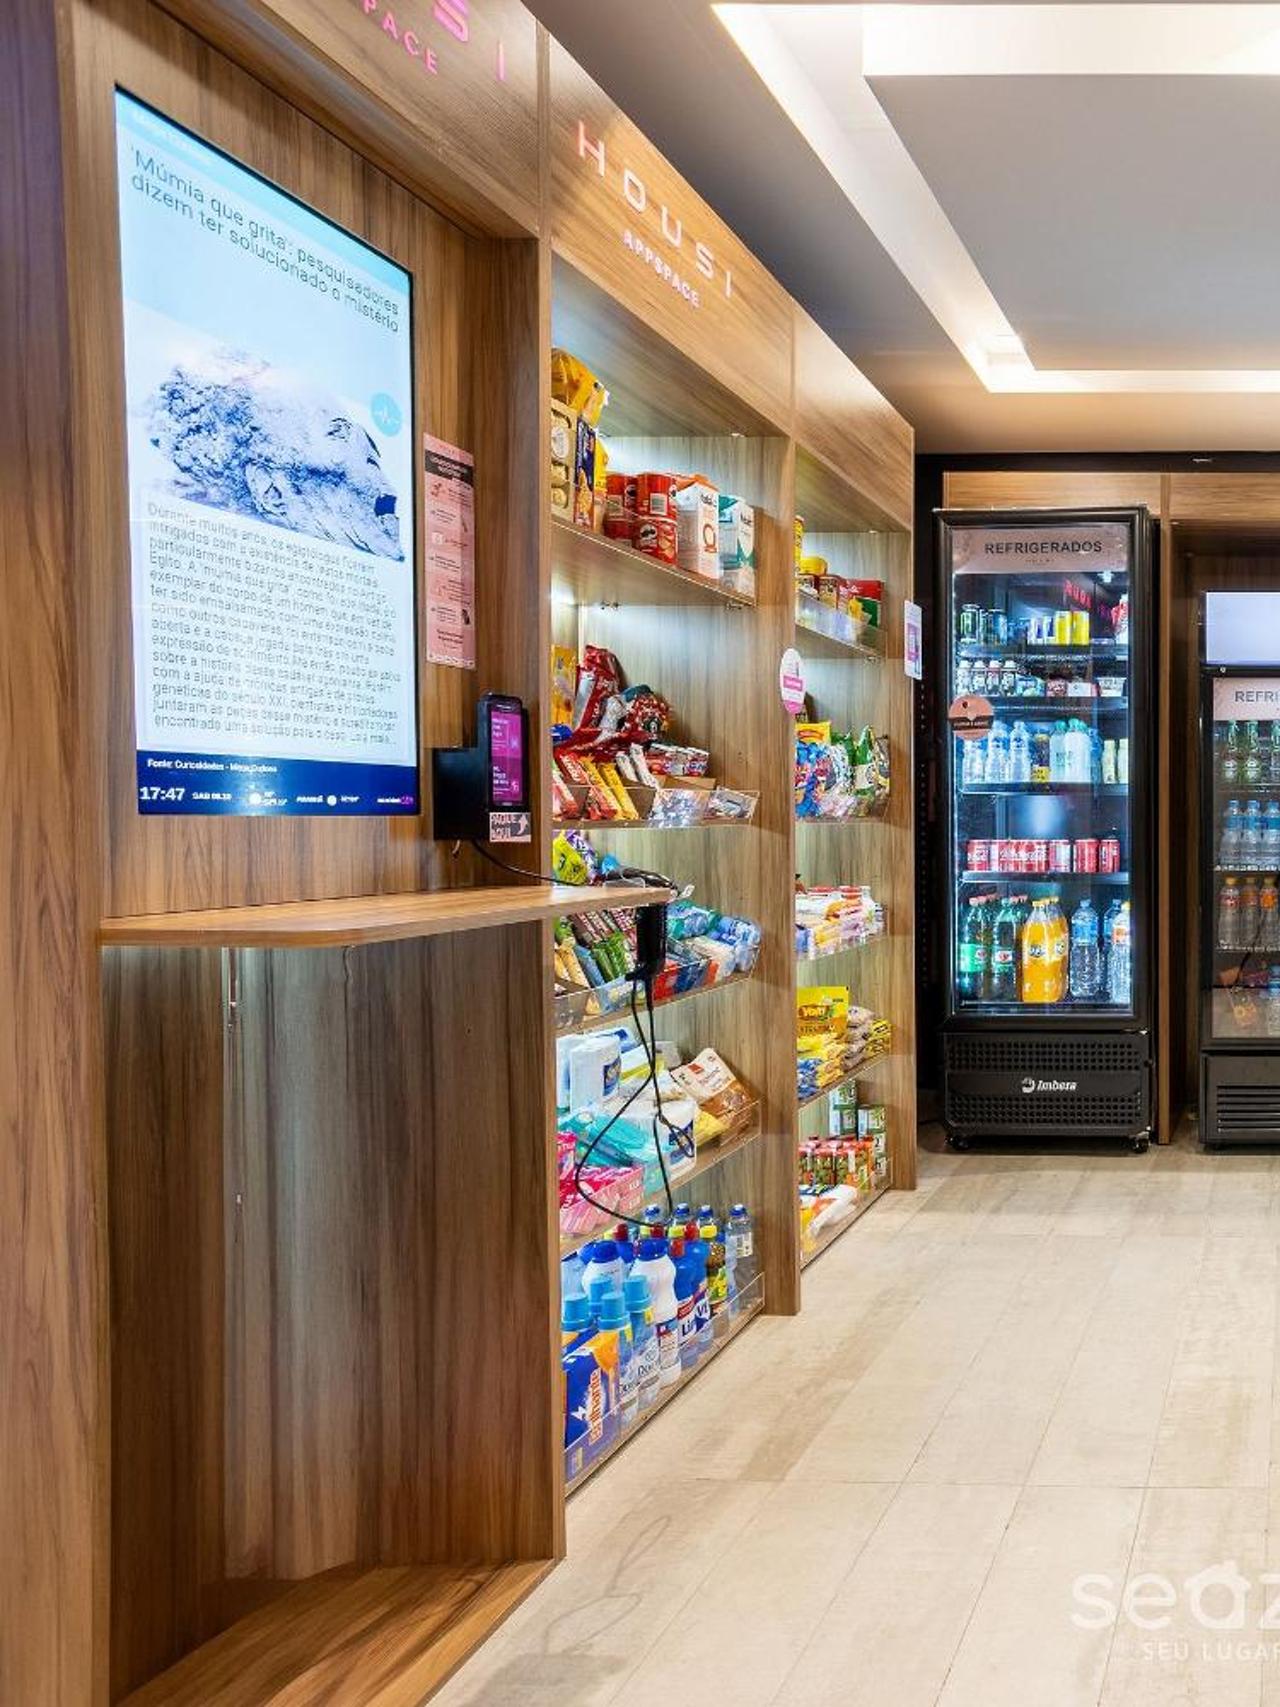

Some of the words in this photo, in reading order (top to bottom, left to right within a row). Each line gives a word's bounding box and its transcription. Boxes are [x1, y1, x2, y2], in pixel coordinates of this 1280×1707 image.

[131, 167, 193, 219] dizem
[199, 206, 222, 235] ter
[229, 228, 327, 295] solucionado
[331, 286, 340, 301] o
[344, 293, 398, 334] mistério
[210, 196, 243, 227] que
[297, 247, 397, 316] pesquisadores
[577, 120, 734, 298] HOUSI
[622, 229, 701, 308] APPSPACE
[984, 541, 1103, 554] REFRIGERADOS
[139, 787, 185, 800] 17:47
